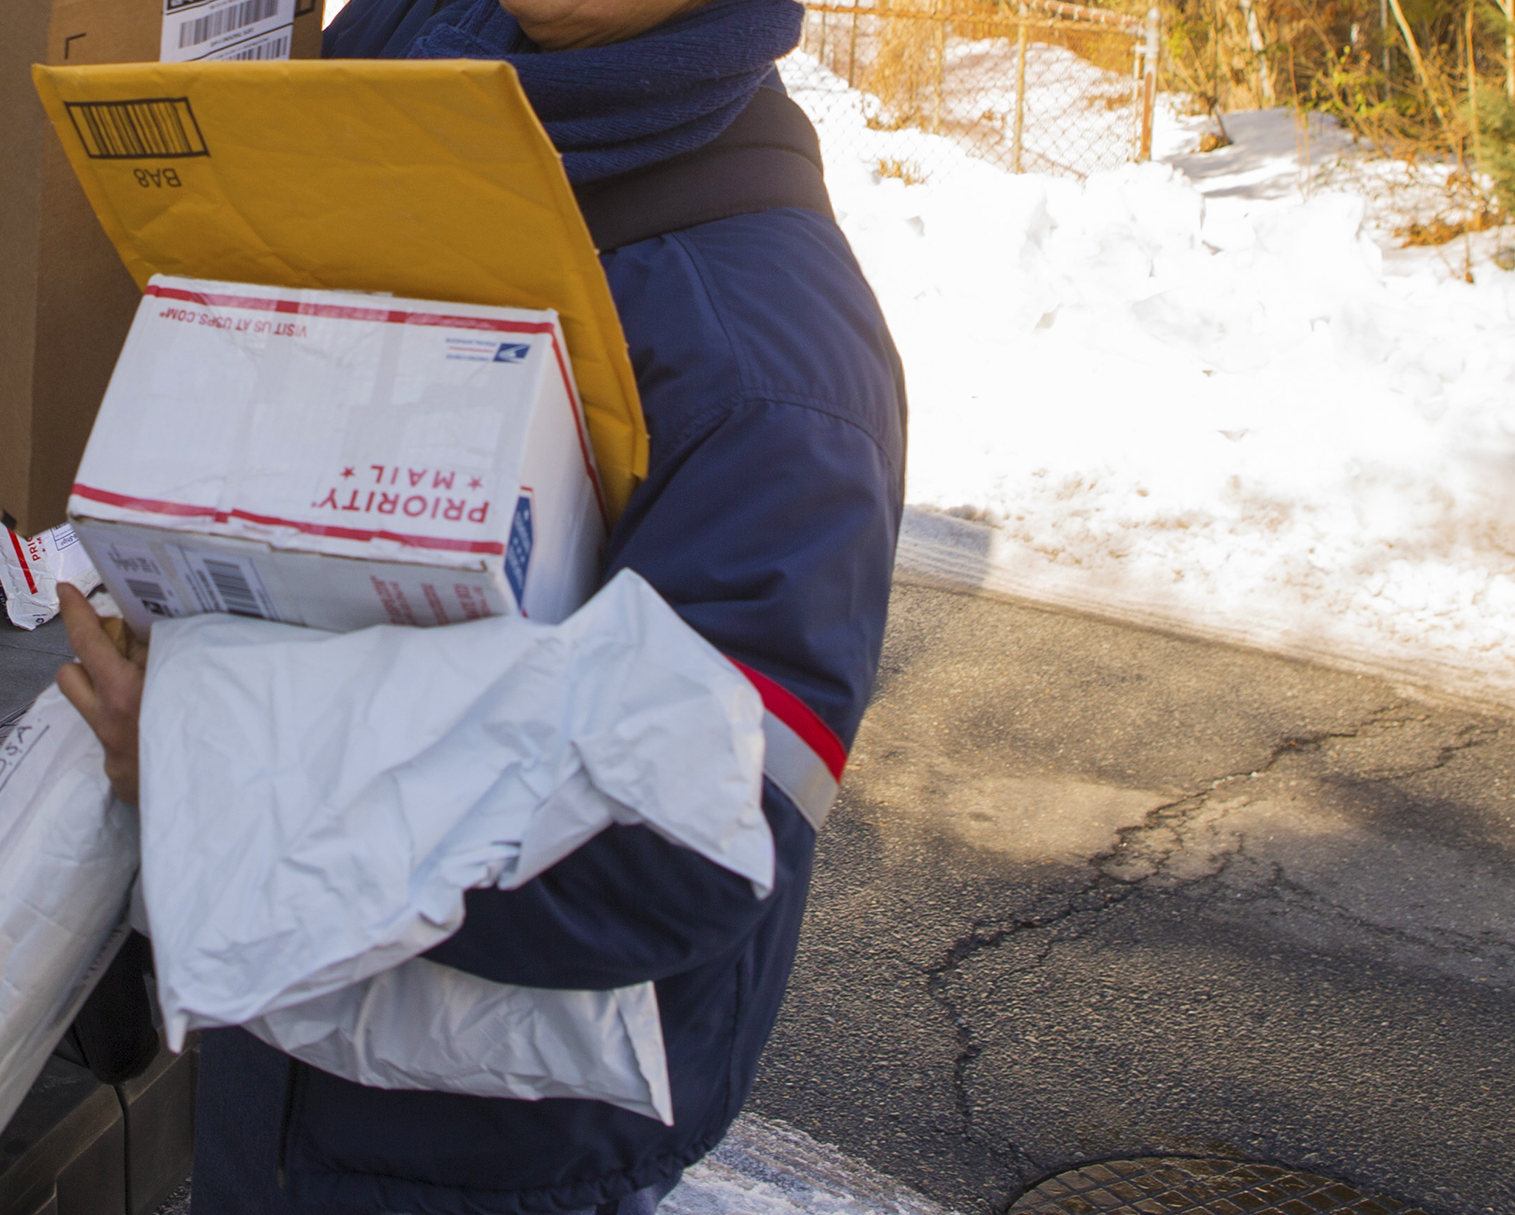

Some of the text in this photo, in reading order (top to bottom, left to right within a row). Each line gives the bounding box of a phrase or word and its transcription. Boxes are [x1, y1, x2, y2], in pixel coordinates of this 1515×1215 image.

[133, 168, 182, 188] BA8
[236, 318, 251, 331] AT
[254, 320, 271, 333] US
[274, 322, 307, 338] VISIT
[370, 465, 455, 490] MAIL
[318, 488, 489, 524] PRIORITY
